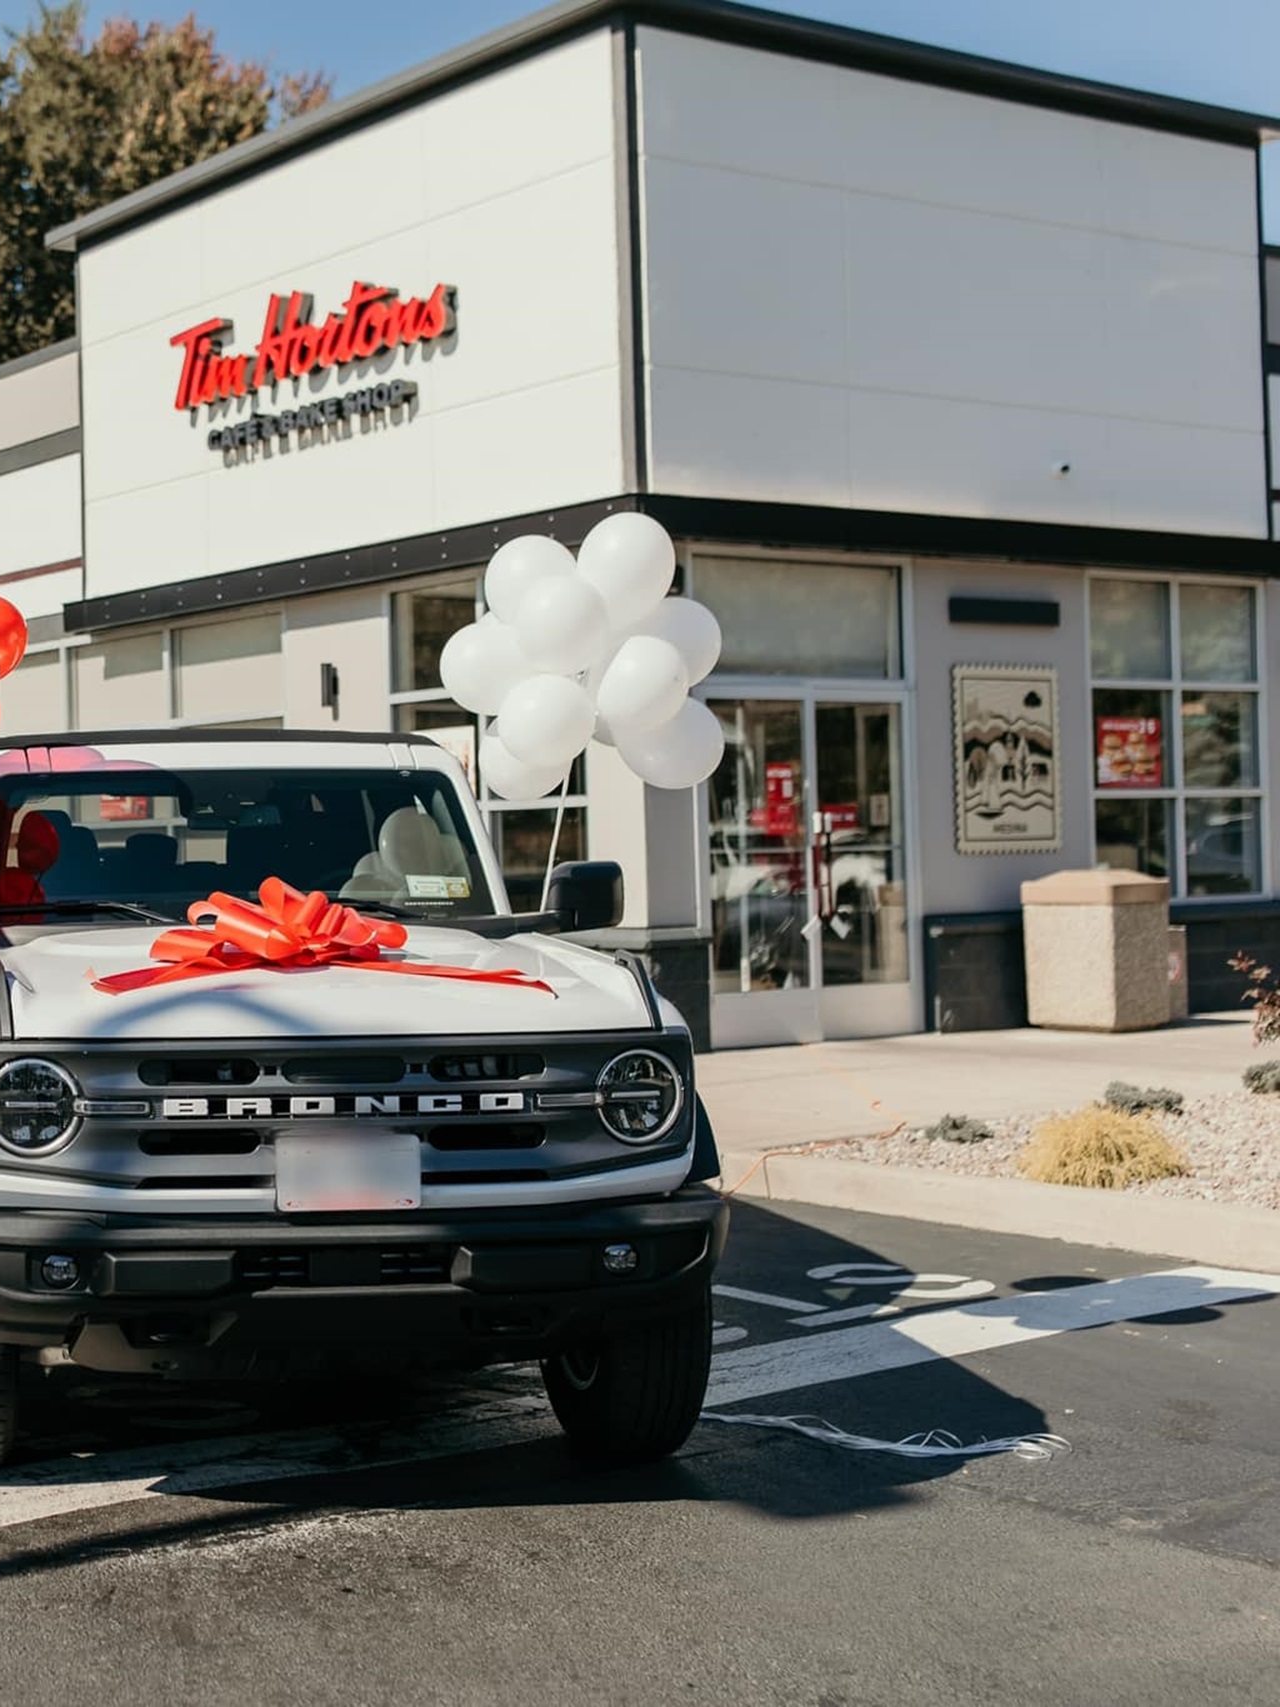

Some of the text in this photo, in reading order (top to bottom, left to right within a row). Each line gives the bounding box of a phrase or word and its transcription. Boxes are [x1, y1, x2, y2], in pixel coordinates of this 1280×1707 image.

[170, 281, 449, 411] Tim Hortons
[278, 398, 338, 434] BAKE
[342, 379, 407, 418] SHOP
[163, 1092, 524, 1119] BRONCO
